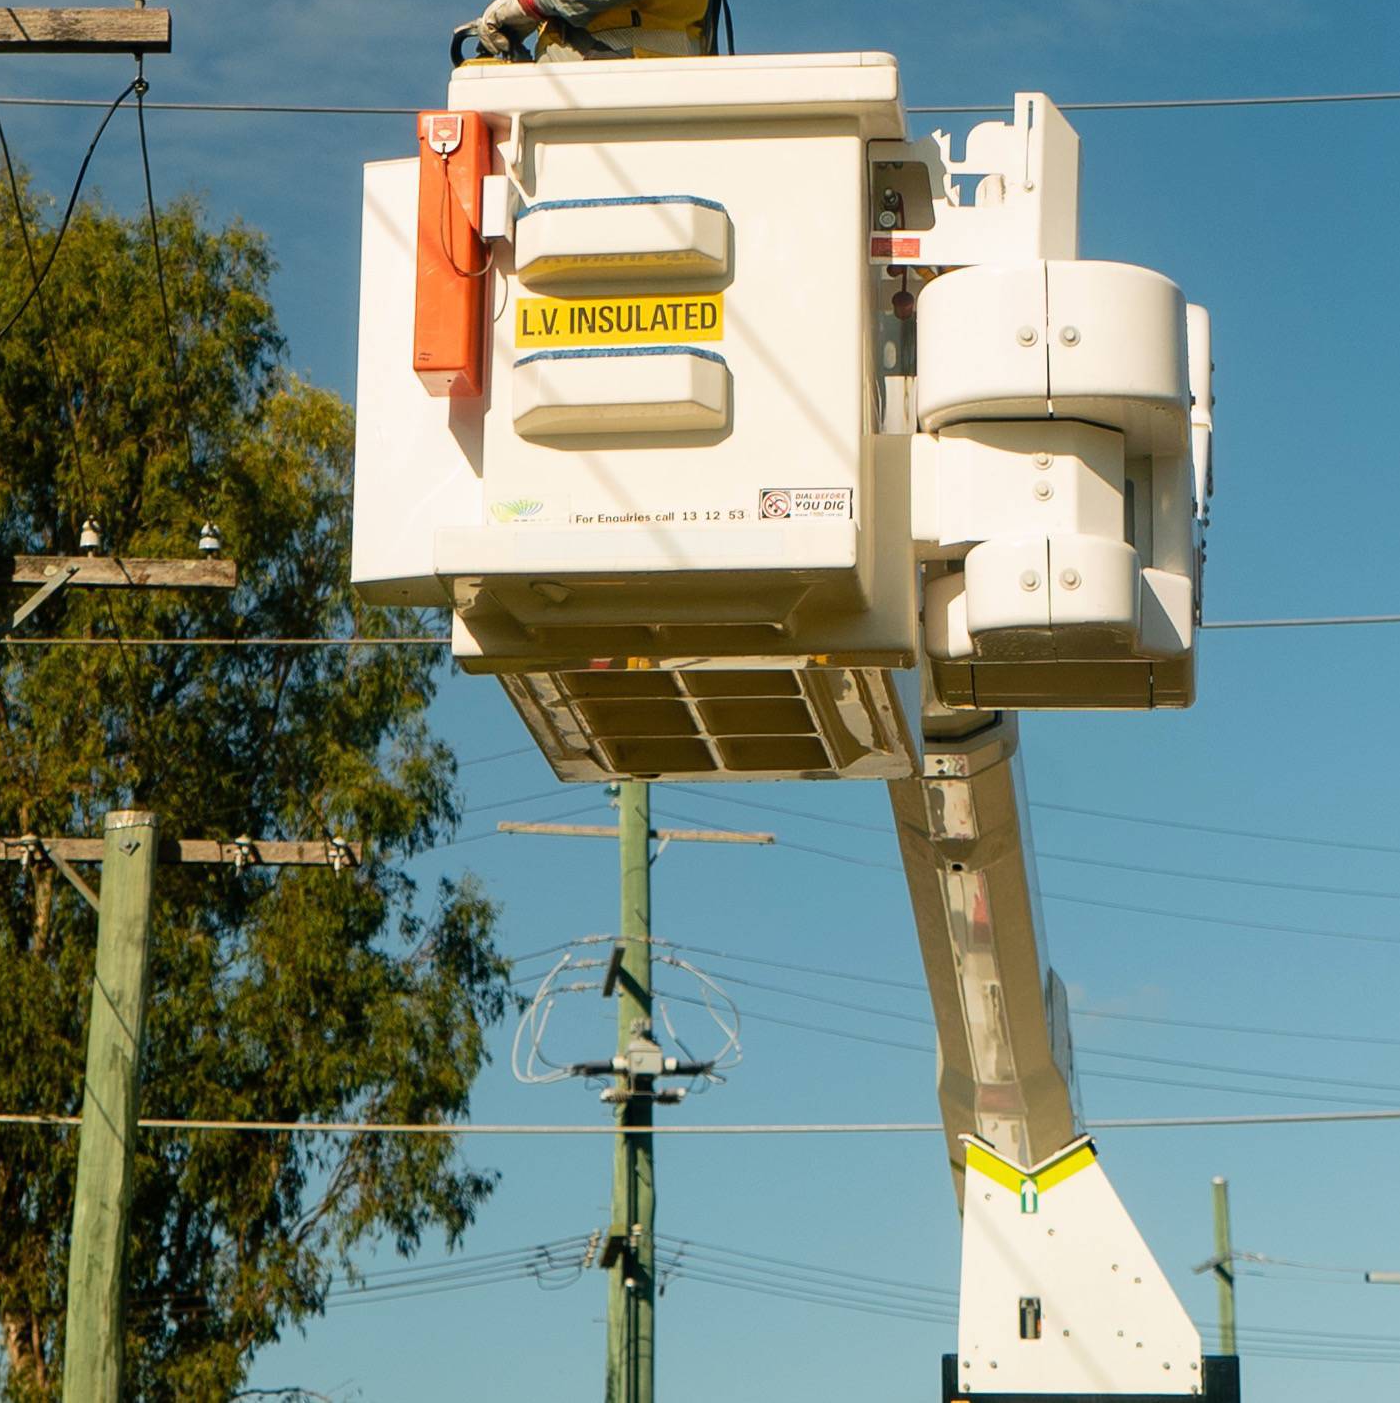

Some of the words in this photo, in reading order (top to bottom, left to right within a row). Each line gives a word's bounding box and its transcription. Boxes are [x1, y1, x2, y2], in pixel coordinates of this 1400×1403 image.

[522, 308, 560, 336] L.V.
[569, 302, 718, 335] INSULATED
[795, 492, 813, 500] DIAL
[795, 500, 820, 511] YOU
[823, 500, 845, 511] DIG
[575, 514, 594, 524] For
[655, 511, 675, 522] call
[682, 511, 697, 521] 13
[705, 510, 720, 521] 12
[728, 510, 745, 521] 53
